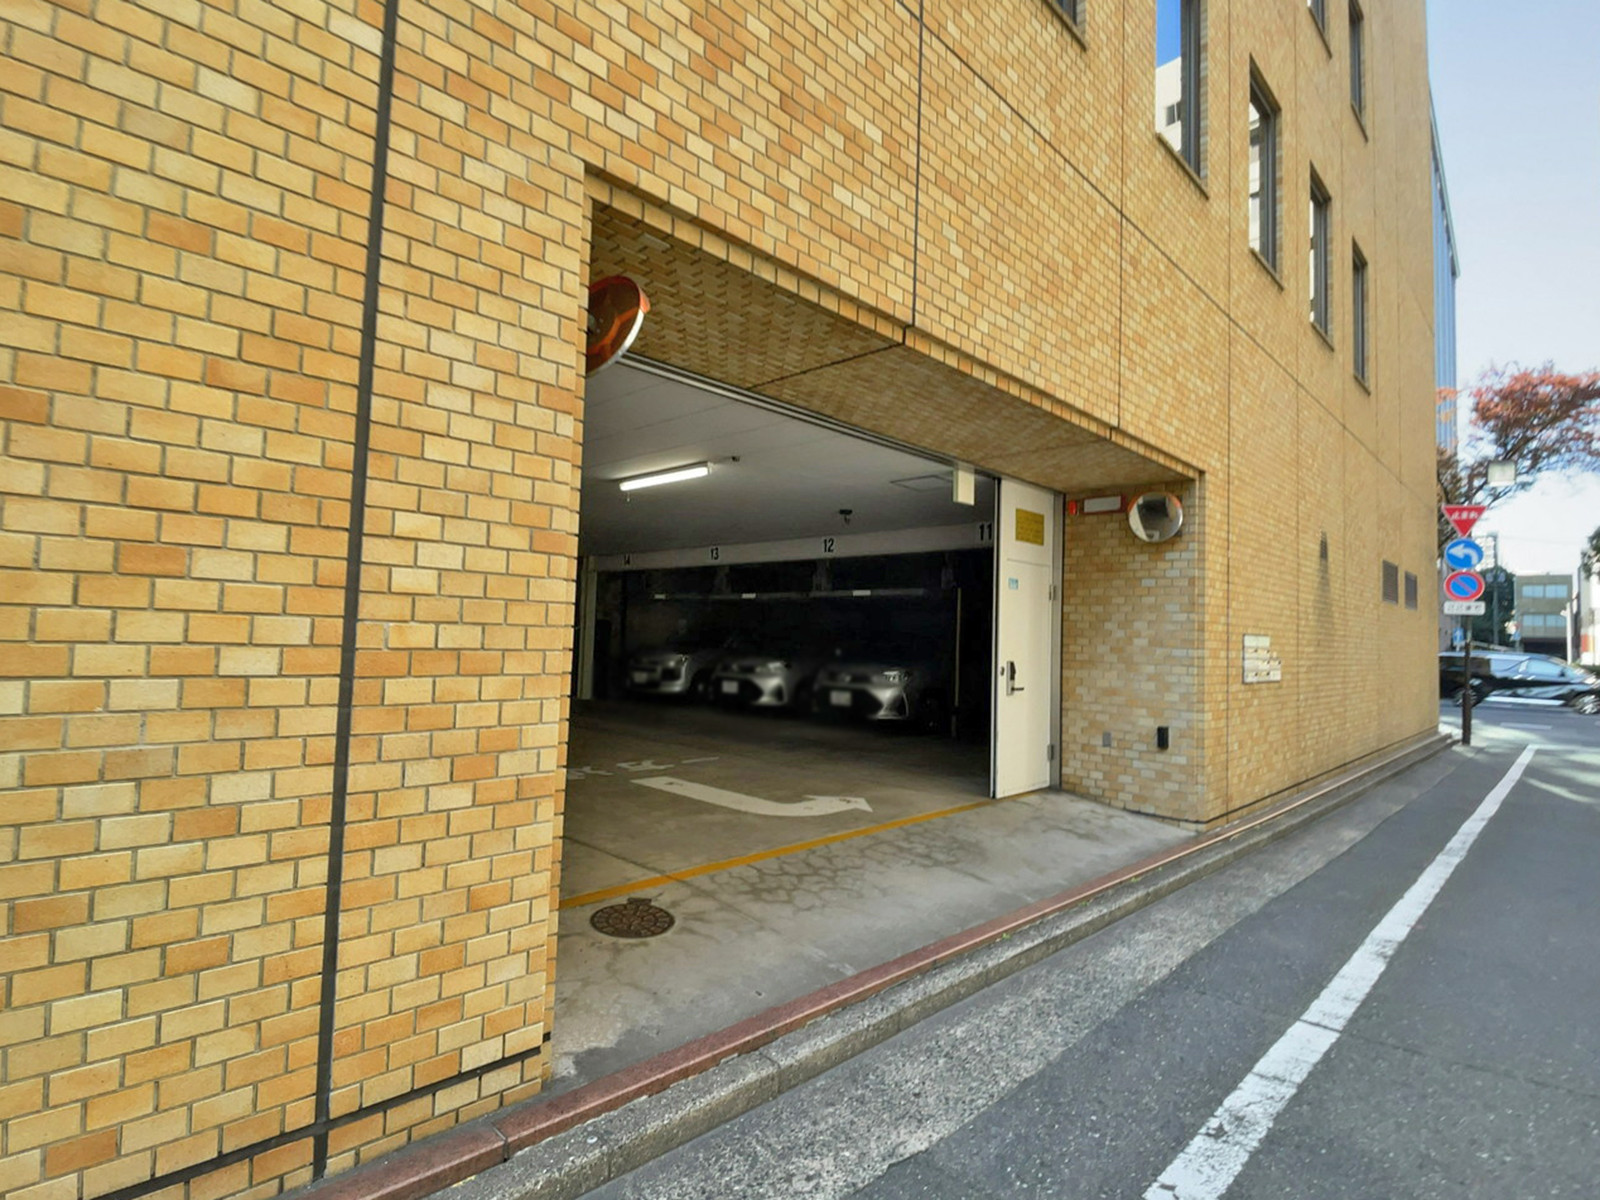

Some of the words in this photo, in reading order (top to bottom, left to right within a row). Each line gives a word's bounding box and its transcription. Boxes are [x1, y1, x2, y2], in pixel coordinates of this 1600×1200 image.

[979, 523, 993, 541] 11
[823, 538, 834, 553] 12
[710, 547, 719, 560] 13
